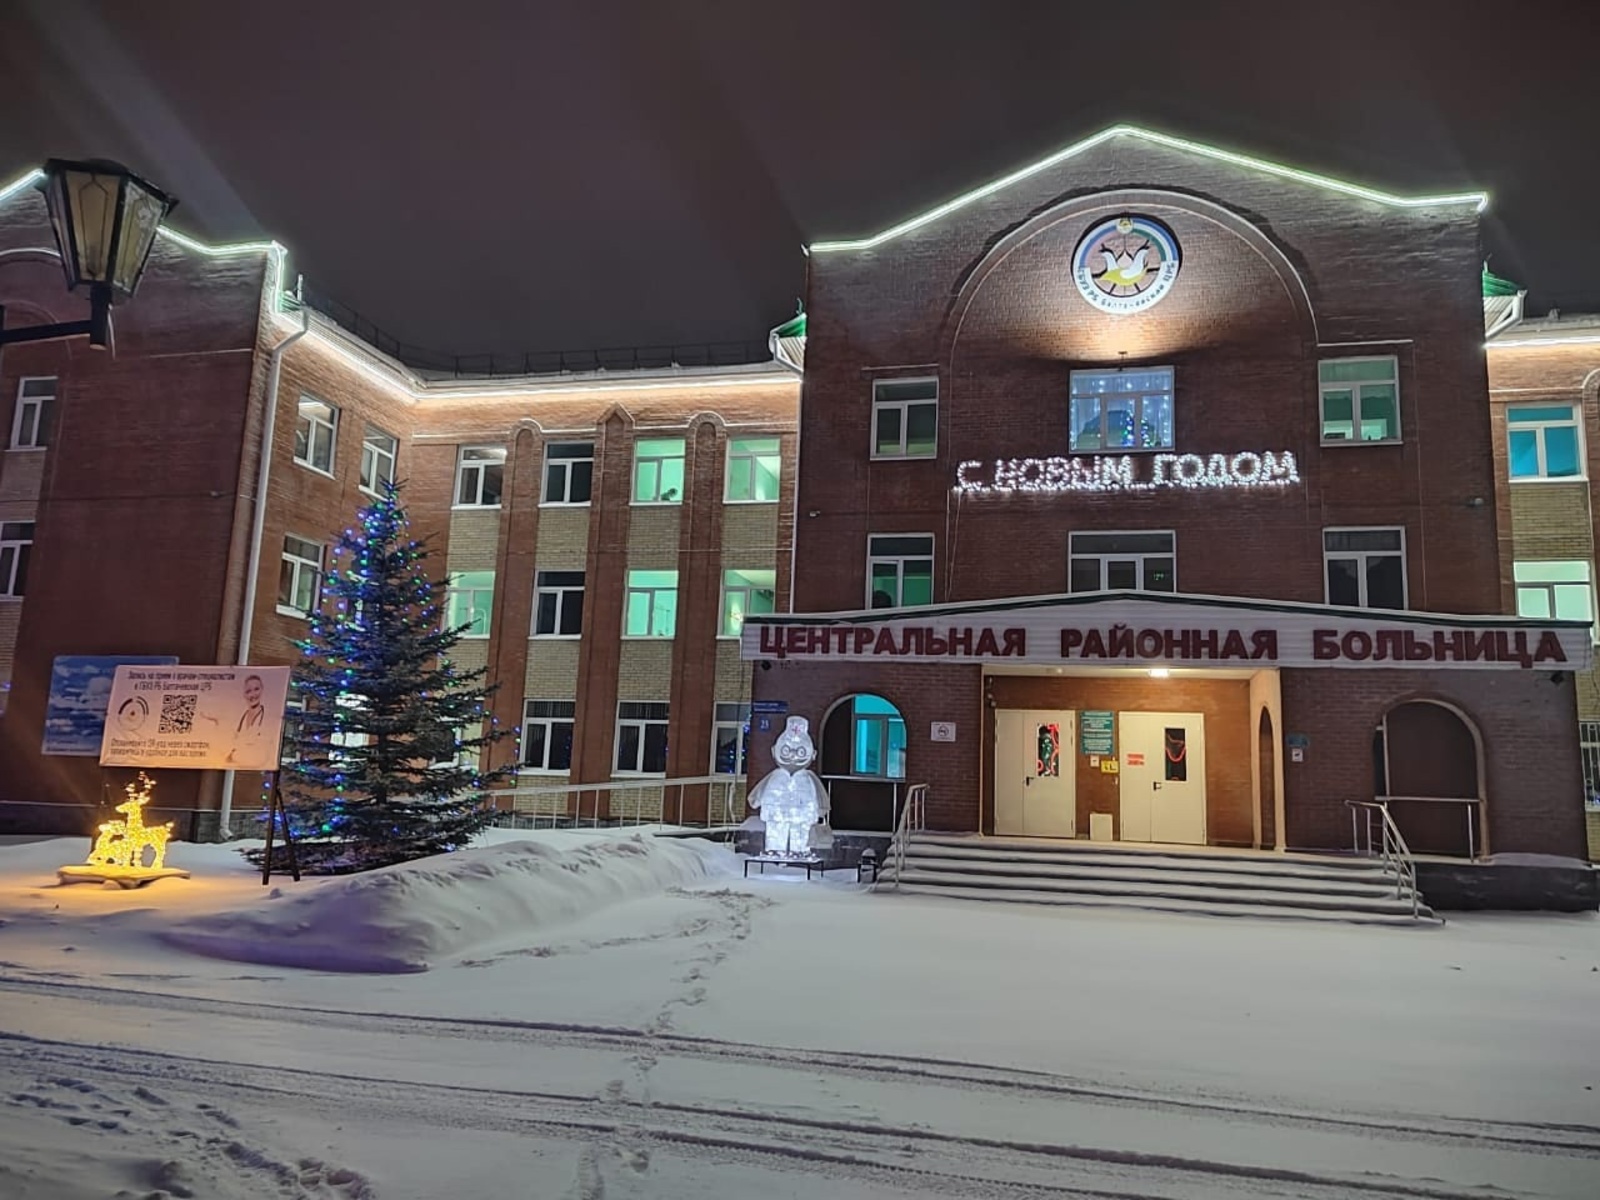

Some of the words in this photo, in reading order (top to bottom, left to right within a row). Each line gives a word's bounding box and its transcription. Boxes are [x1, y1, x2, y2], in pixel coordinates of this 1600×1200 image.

[957, 460, 982, 490] С
[995, 455, 1132, 491] НОВЫМ
[1153, 450, 1300, 488] ГОДОМ
[759, 626, 1026, 659] ЦЕНТРАЛЬНАЯ
[1061, 623, 1277, 659] РАЙОННАЯ
[1313, 629, 1568, 668] БОЛЬНИЦА
